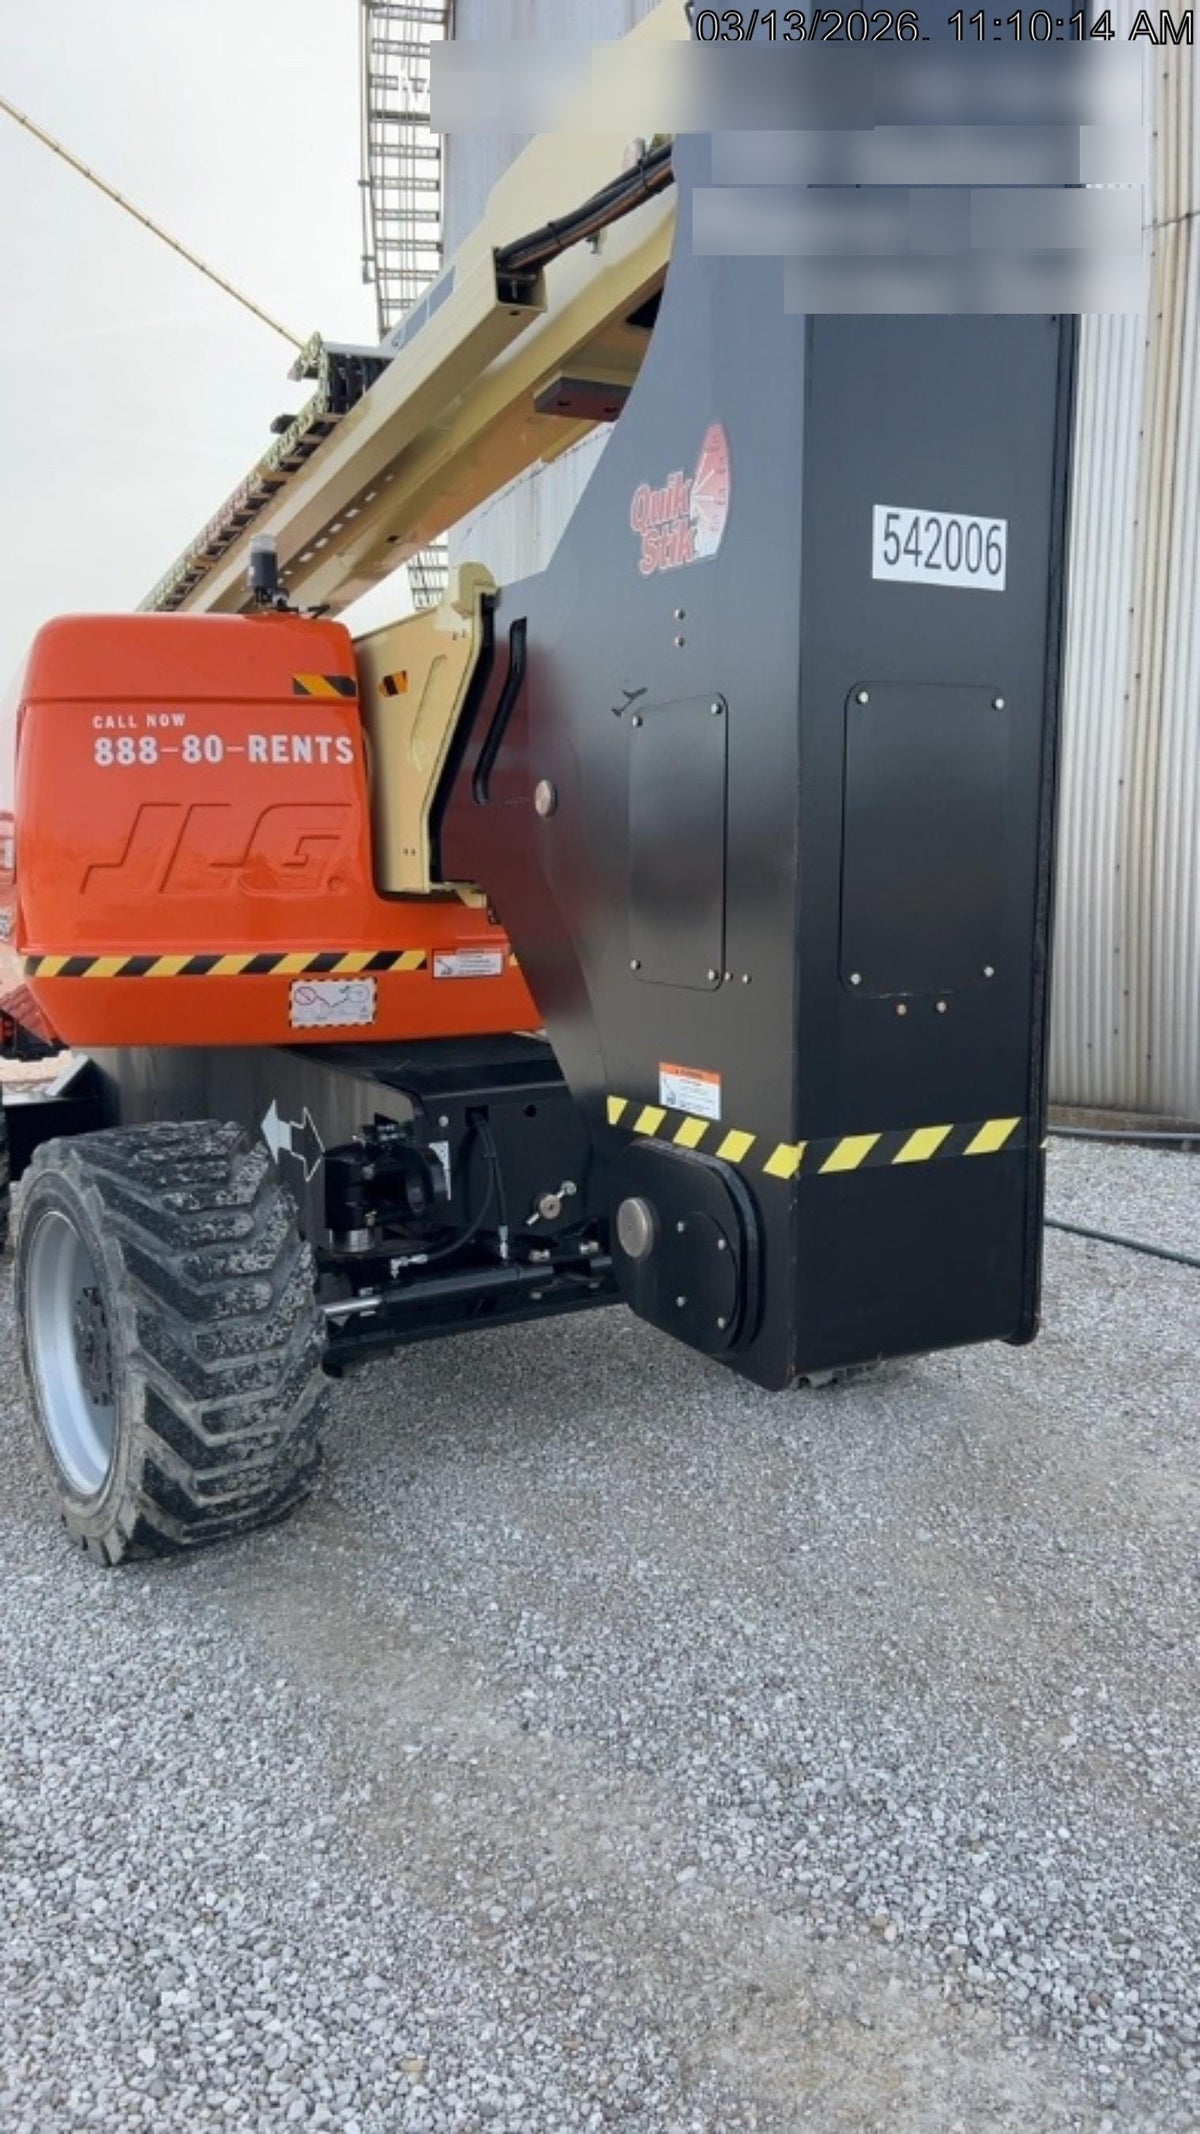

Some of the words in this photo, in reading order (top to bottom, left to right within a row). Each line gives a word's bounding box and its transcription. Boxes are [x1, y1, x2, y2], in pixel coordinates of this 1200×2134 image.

[883, 513, 1003, 576] 542006
[92, 714, 138, 729] CALL
[146, 713, 187, 728] NOW
[94, 734, 355, 767] 888-80-RENTS
